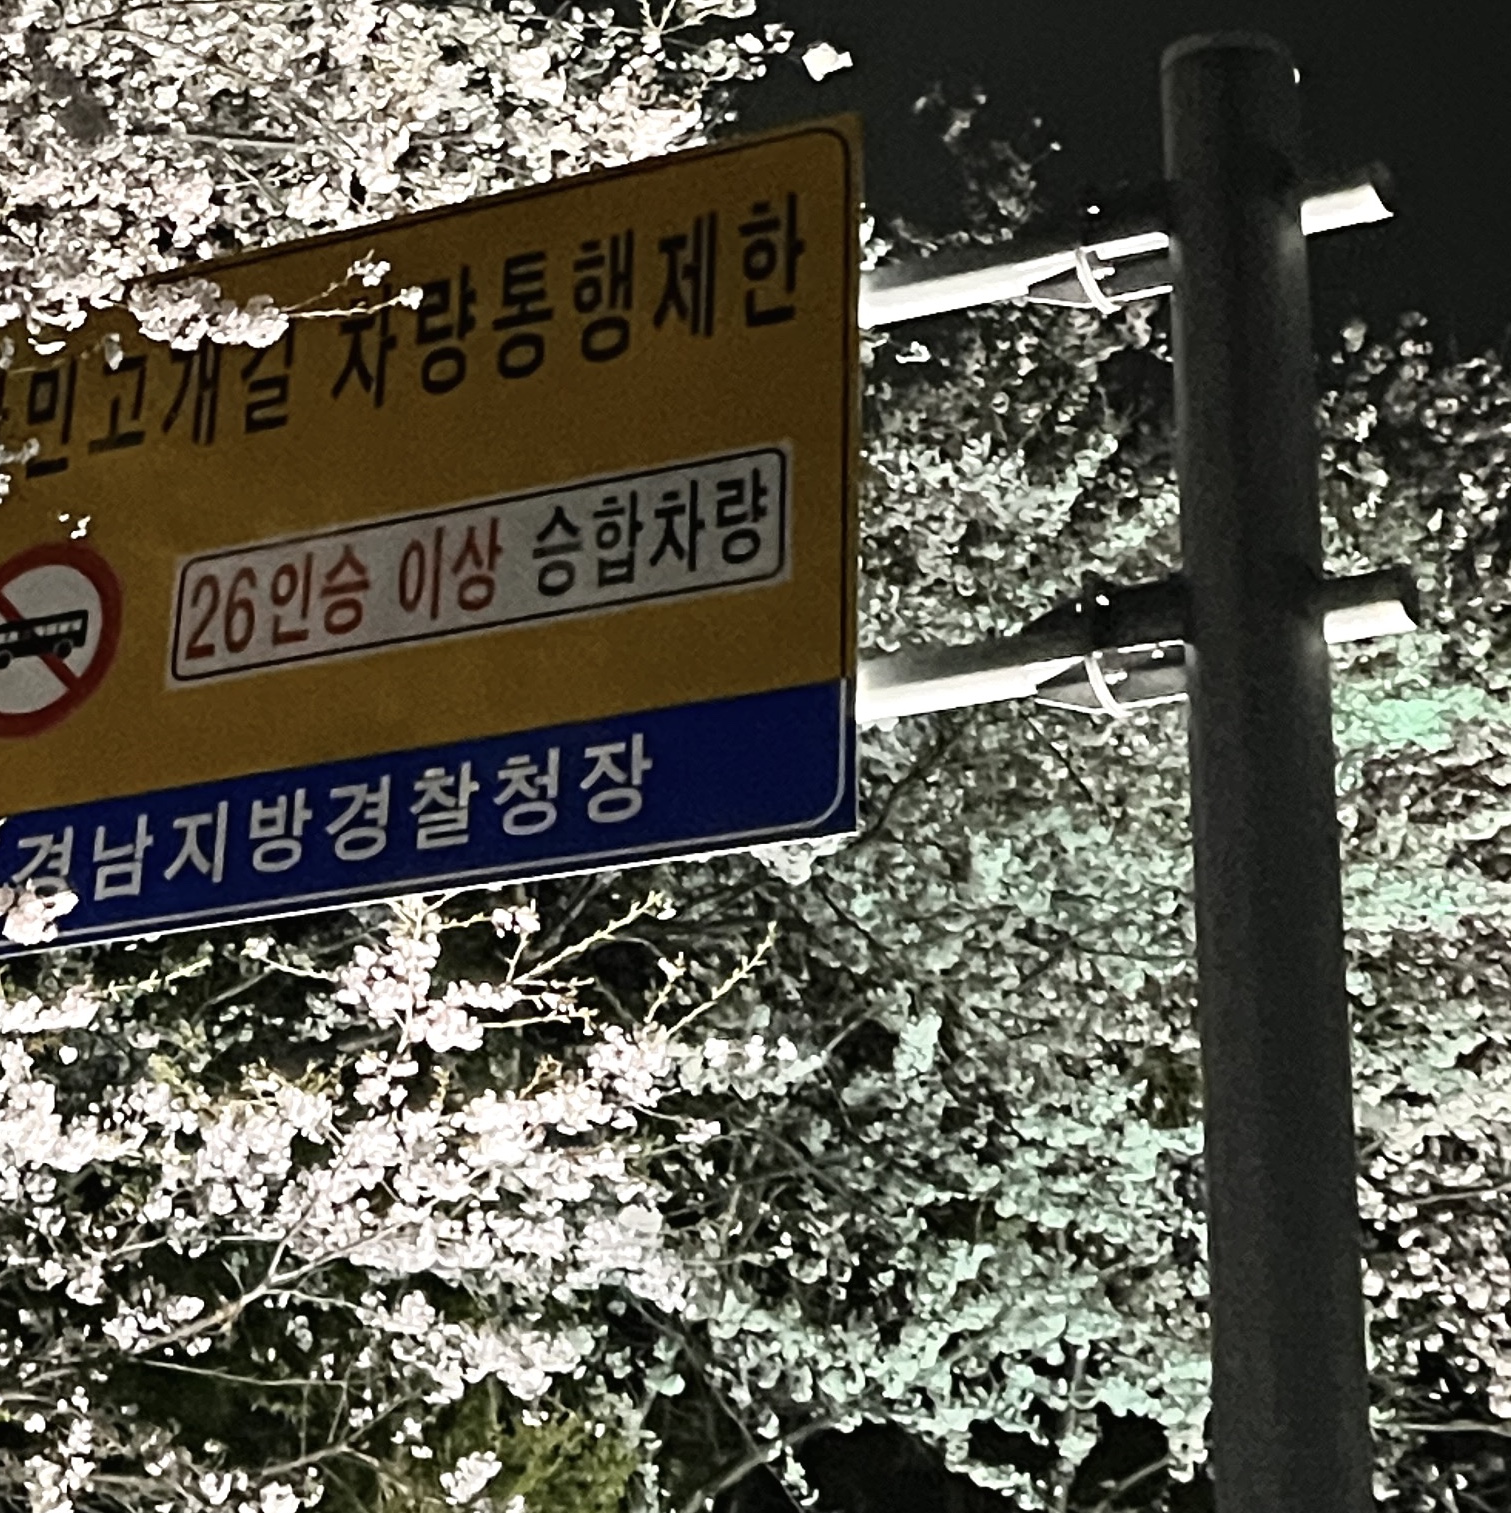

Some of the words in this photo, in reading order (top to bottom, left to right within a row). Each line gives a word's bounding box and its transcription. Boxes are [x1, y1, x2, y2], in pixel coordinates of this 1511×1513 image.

[330, 192, 806, 400] 차량통행제한
[184, 544, 371, 661] 26인승
[398, 516, 504, 620] 이상
[530, 467, 770, 598] 승합차량
[9, 733, 656, 903] 경남지방경찰청장
